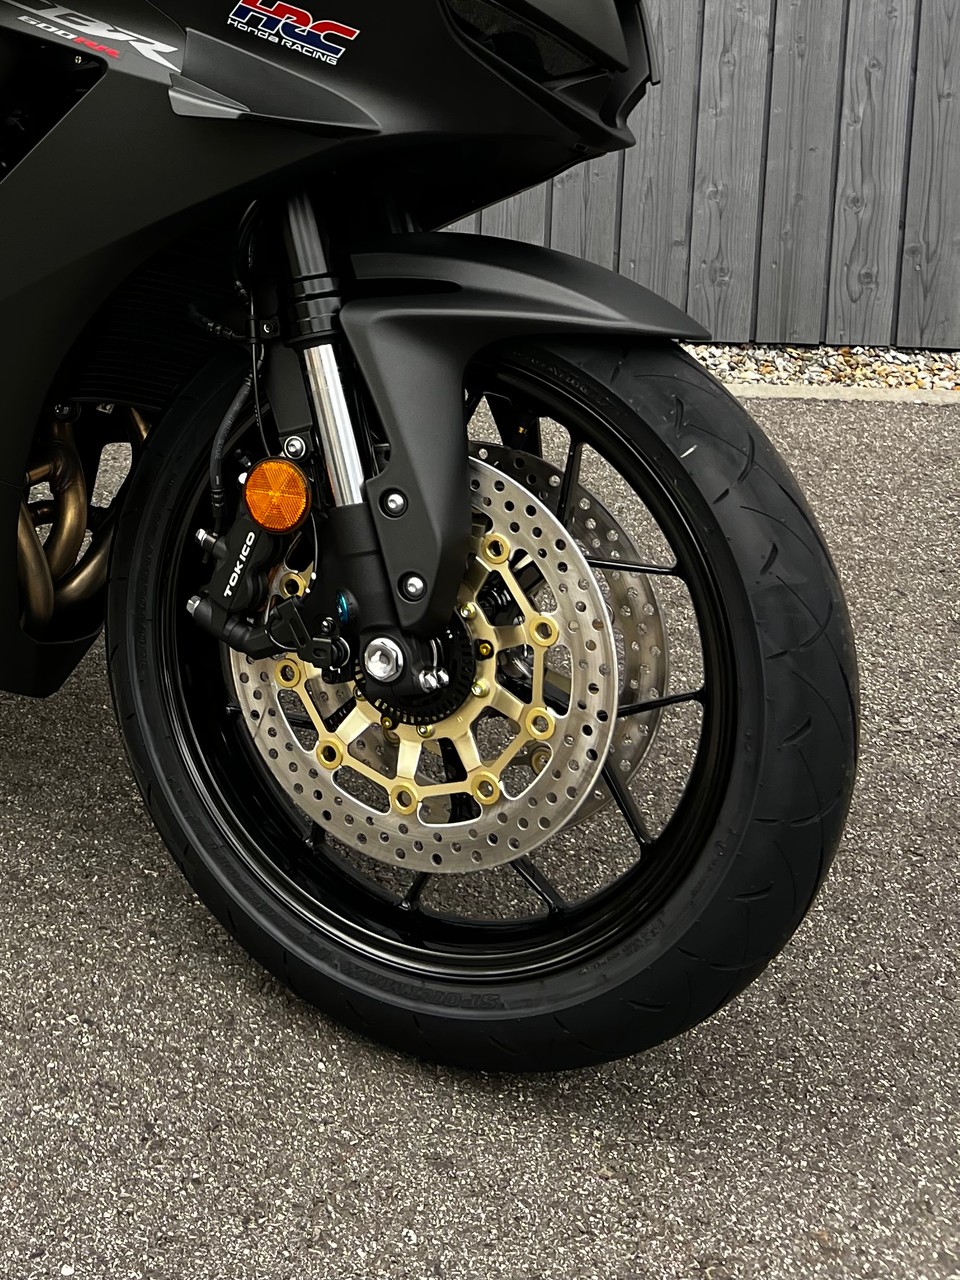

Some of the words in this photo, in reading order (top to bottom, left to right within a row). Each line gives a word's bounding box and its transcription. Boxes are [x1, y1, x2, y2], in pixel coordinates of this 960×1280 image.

[226, 17, 279, 44] Honda
[280, 38, 338, 66] RACING
[223, 531, 257, 598] TOKICO
